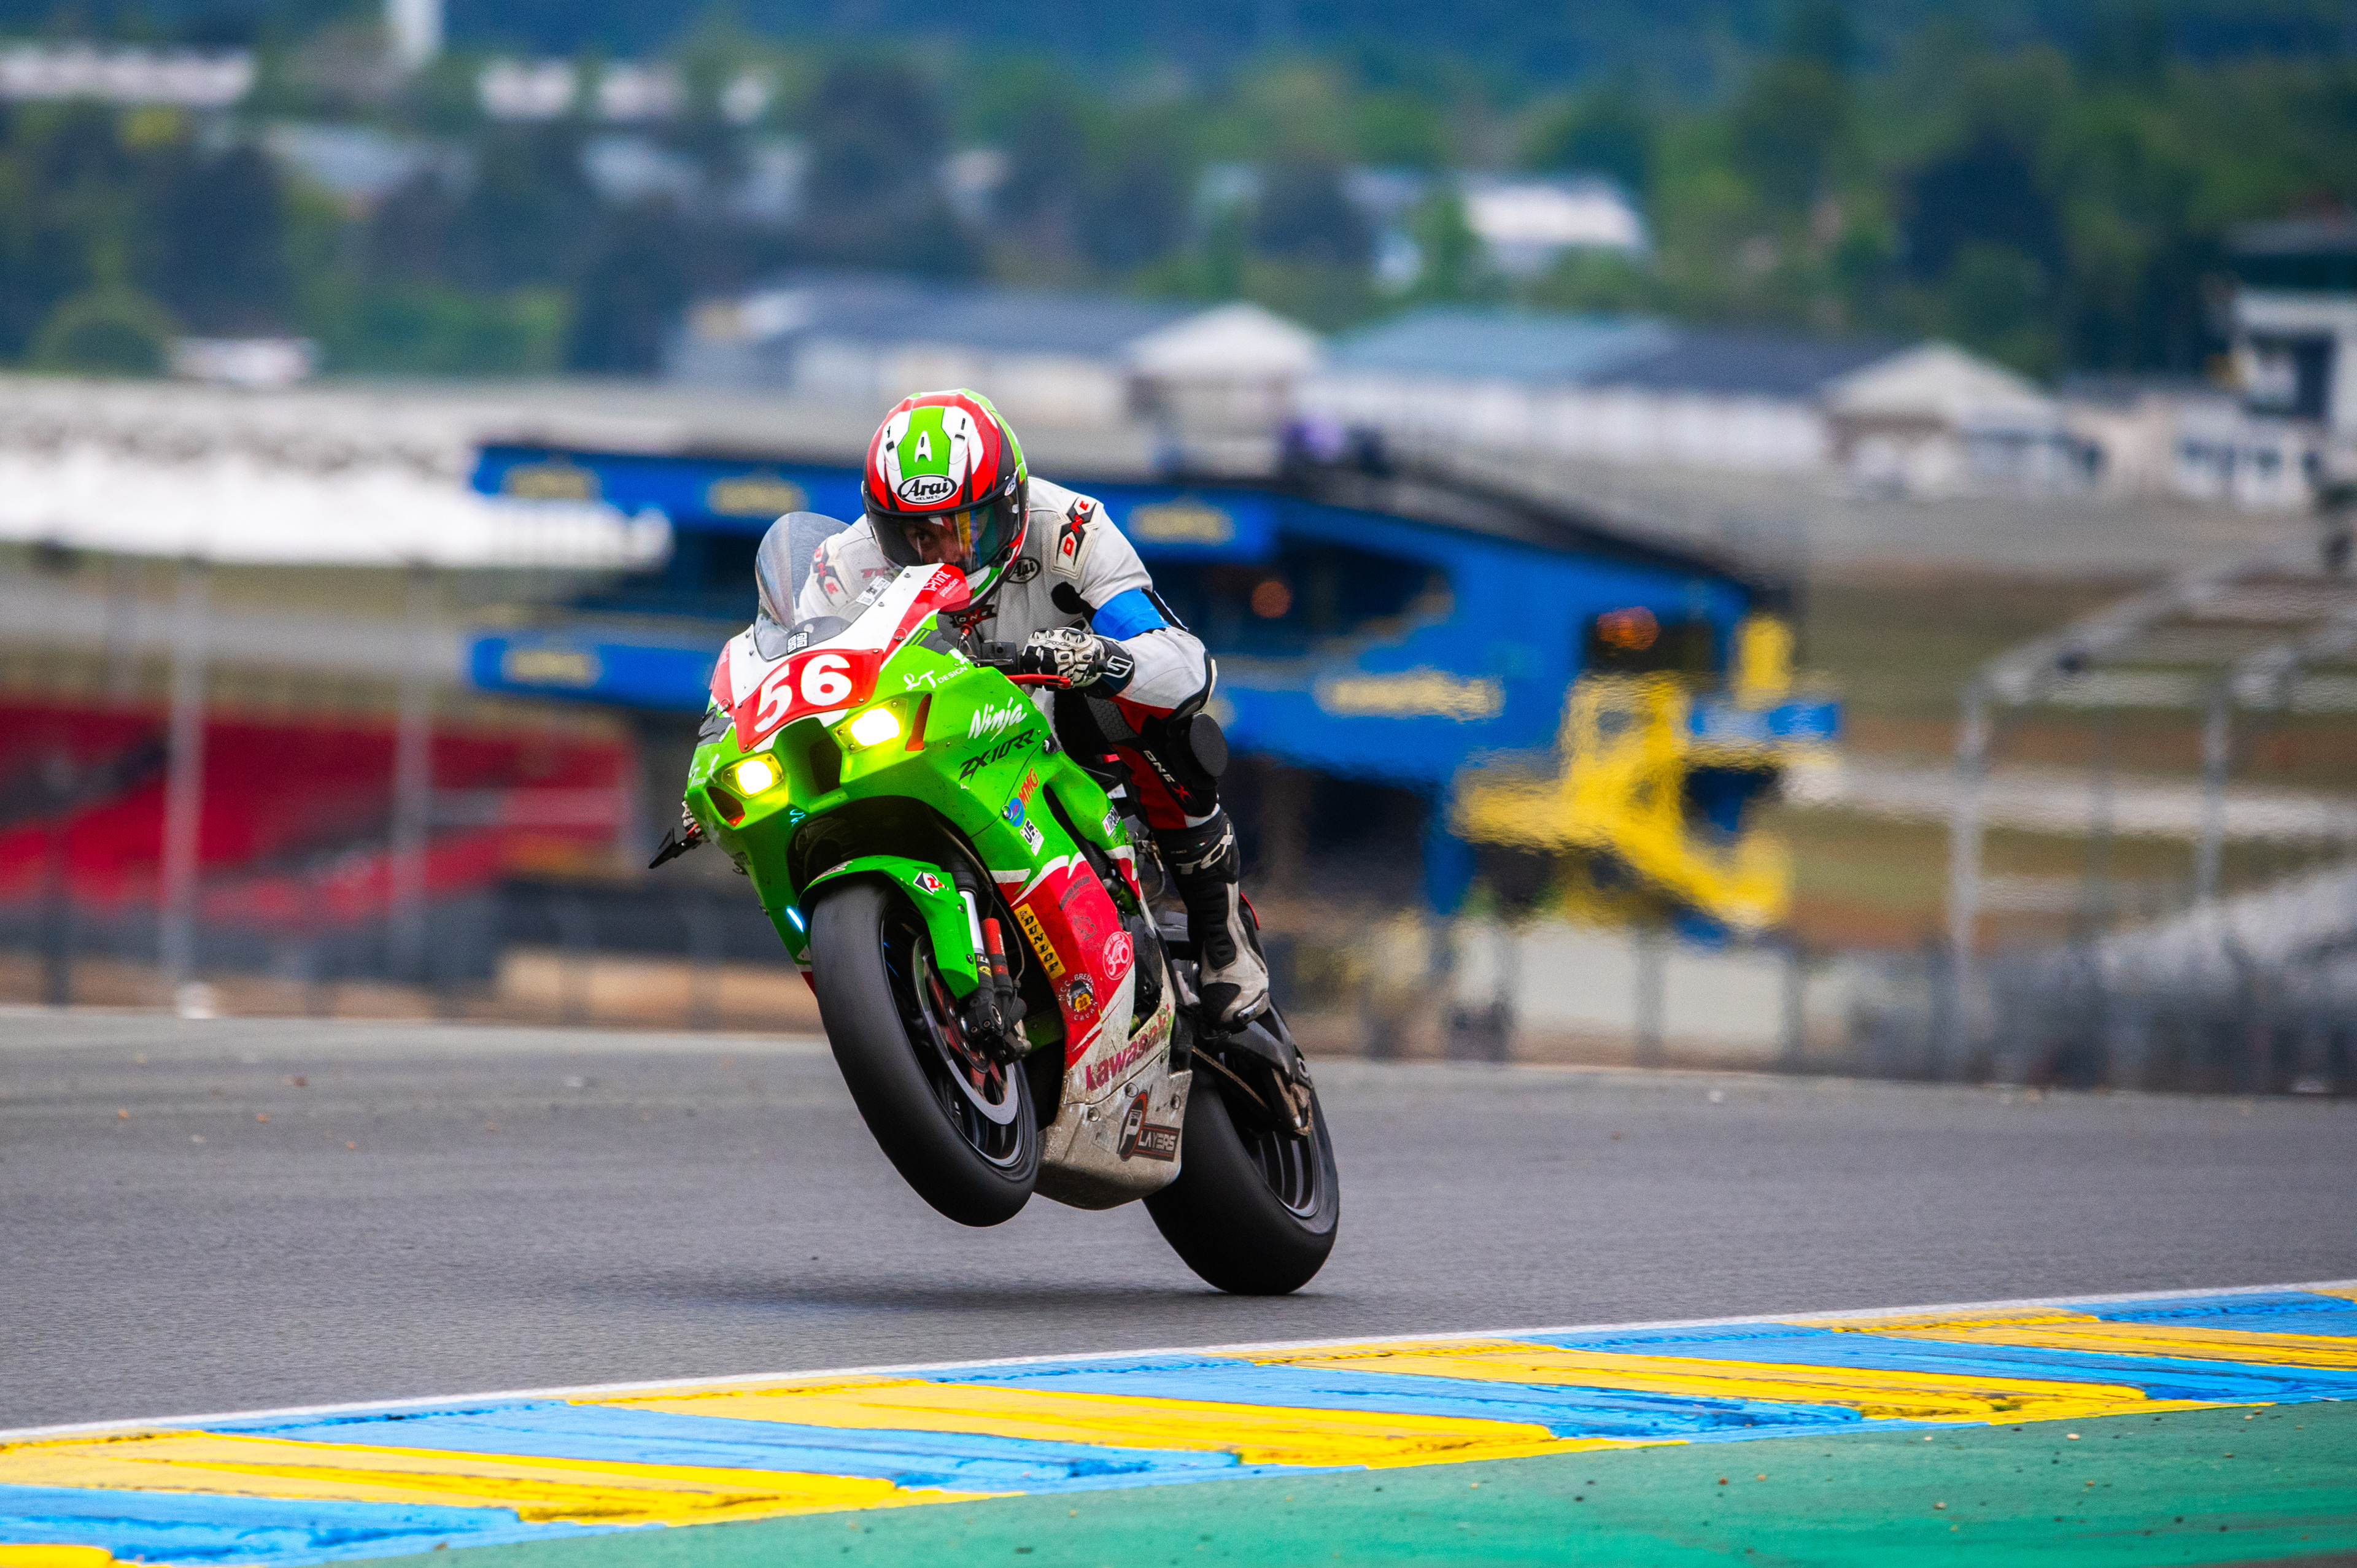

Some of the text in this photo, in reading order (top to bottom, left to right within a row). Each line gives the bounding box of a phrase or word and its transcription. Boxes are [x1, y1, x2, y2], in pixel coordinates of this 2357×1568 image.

[901, 477, 950, 499] Arai
[937, 665, 968, 684] DESIGN
[754, 654, 852, 733] 56
[967, 696, 1028, 743] Ninja
